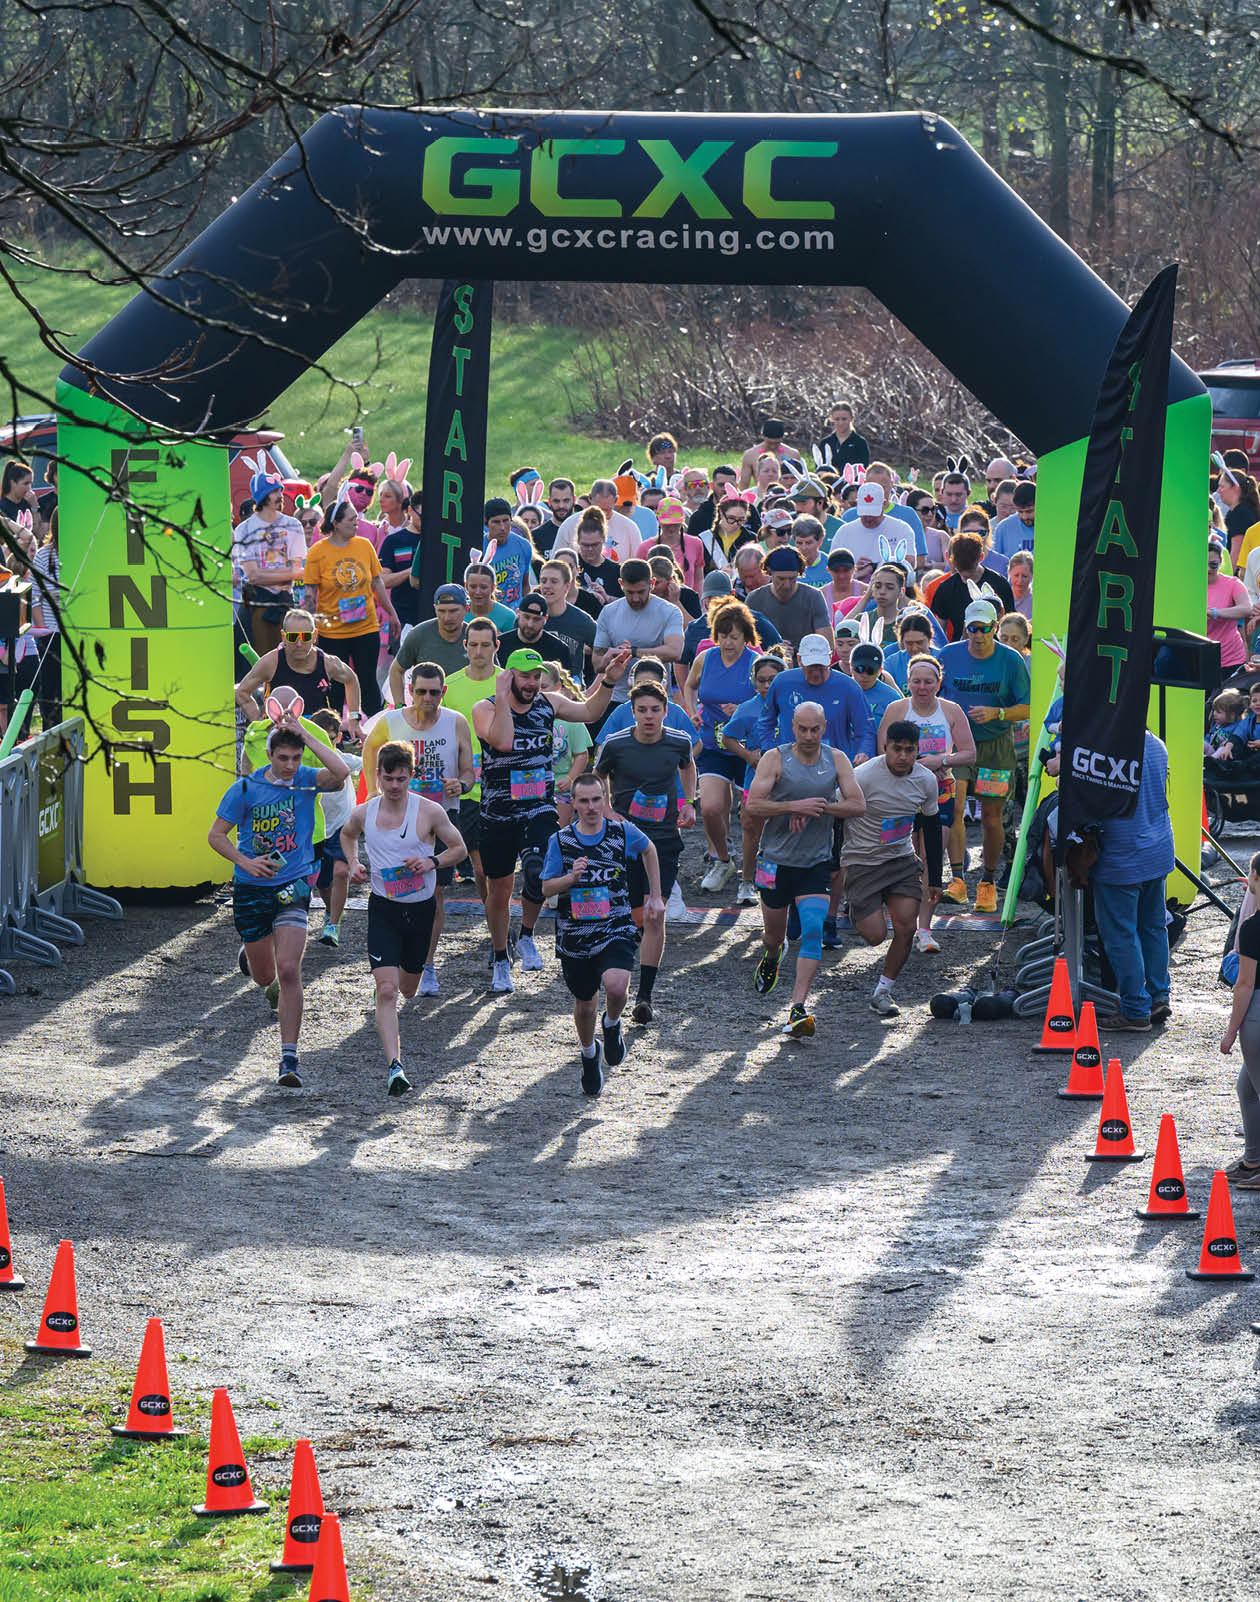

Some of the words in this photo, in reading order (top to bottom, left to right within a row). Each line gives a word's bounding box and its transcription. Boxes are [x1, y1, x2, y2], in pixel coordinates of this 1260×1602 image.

[422, 136, 839, 220] GCXC
[422, 224, 835, 255] www.gcxcracing.com
[441, 284, 474, 584] START
[493, 554, 520, 573] UNNY
[495, 570, 508, 585] OP
[108, 448, 173, 816] FINISH
[424, 737, 447, 748] LAND
[424, 746, 437, 754] OF
[424, 753, 441, 761] THE
[424, 760, 445, 768] FREE
[426, 767, 446, 781] 5K
[252, 817, 280, 833] HOP
[275, 832, 298, 853] 5K
[48, 1317, 74, 1326] GCXC
[140, 1400, 166, 1409] GCXC
[214, 1471, 243, 1480] GCXC
[291, 1523, 320, 1533] GCXC
